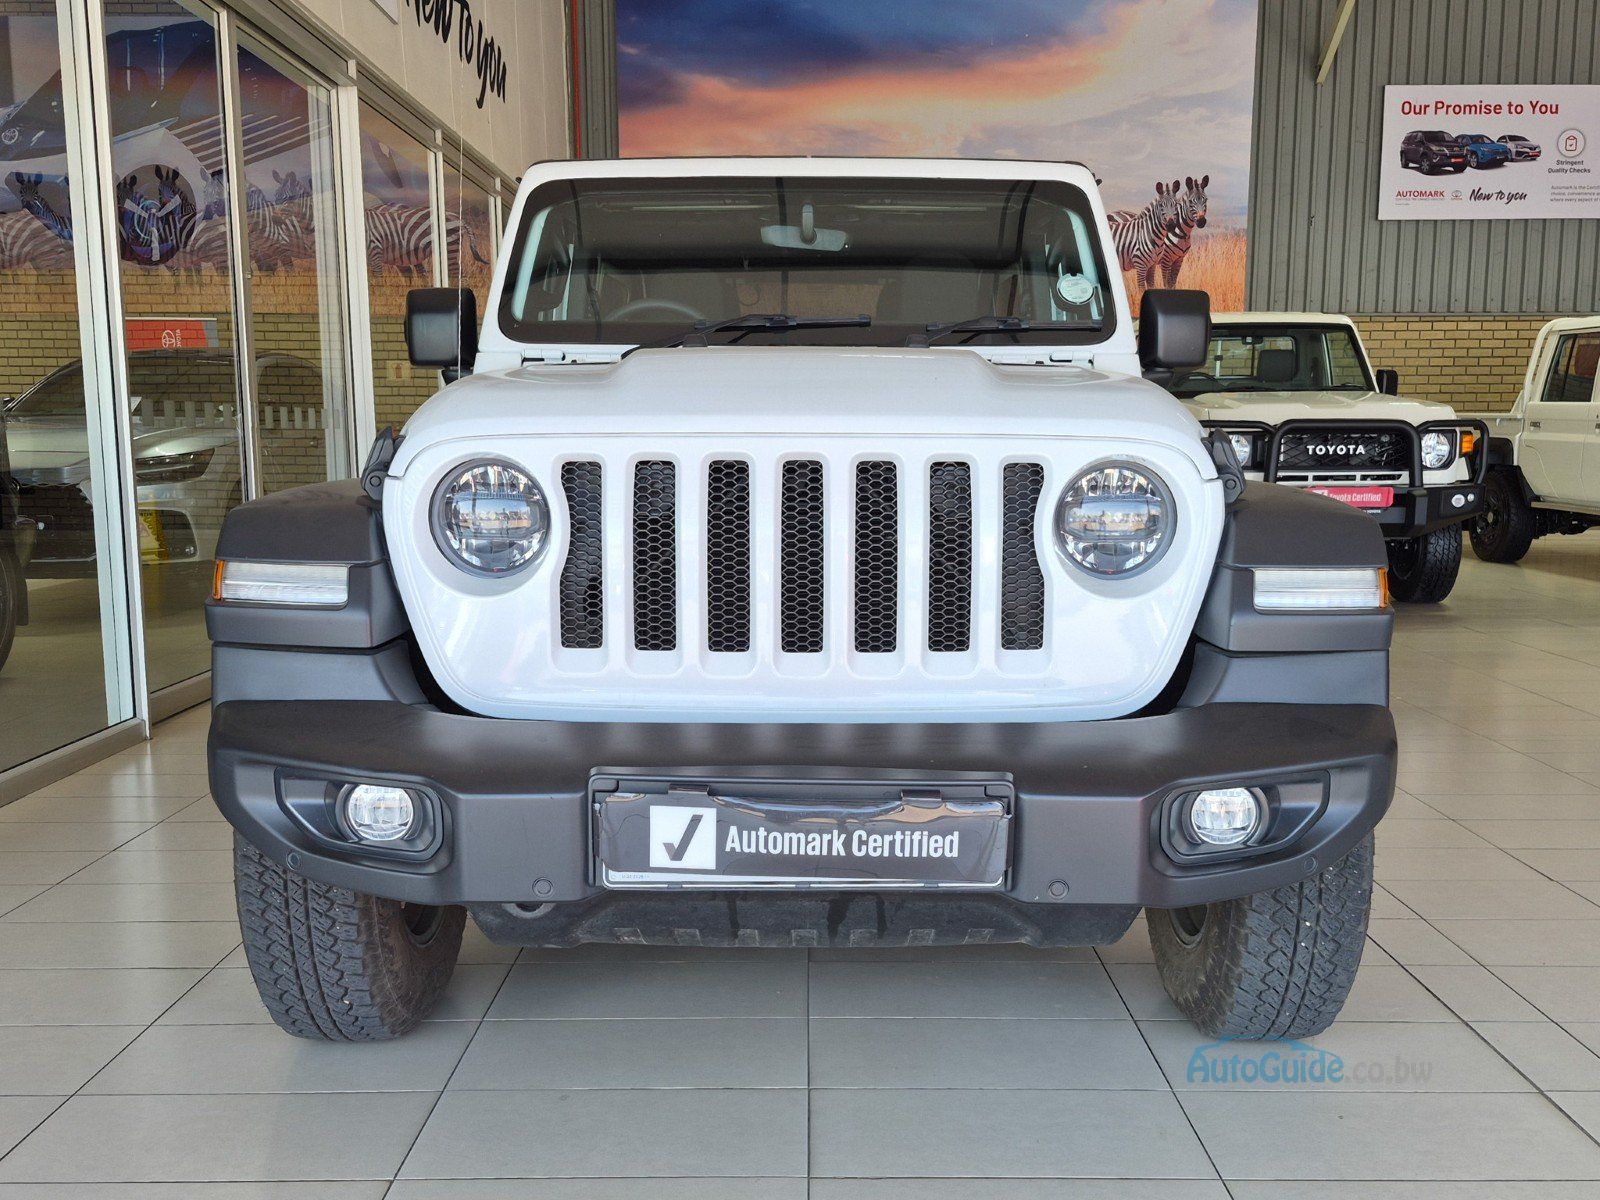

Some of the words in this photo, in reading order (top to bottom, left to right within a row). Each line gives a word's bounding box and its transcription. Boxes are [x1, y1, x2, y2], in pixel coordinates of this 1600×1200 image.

[476, 20, 506, 109] you
[1401, 100, 1429, 115] Our
[1434, 100, 1503, 115] Promise
[1508, 101, 1523, 115] to
[1529, 100, 1559, 115] You
[1396, 190, 1445, 198] AUTOMARK
[1469, 187, 1493, 201] New
[1506, 191, 1528, 204] you
[1306, 445, 1365, 455] TOYOTA
[1352, 493, 1381, 502] Certified
[725, 825, 846, 856] Automark
[852, 830, 959, 857] Certified
